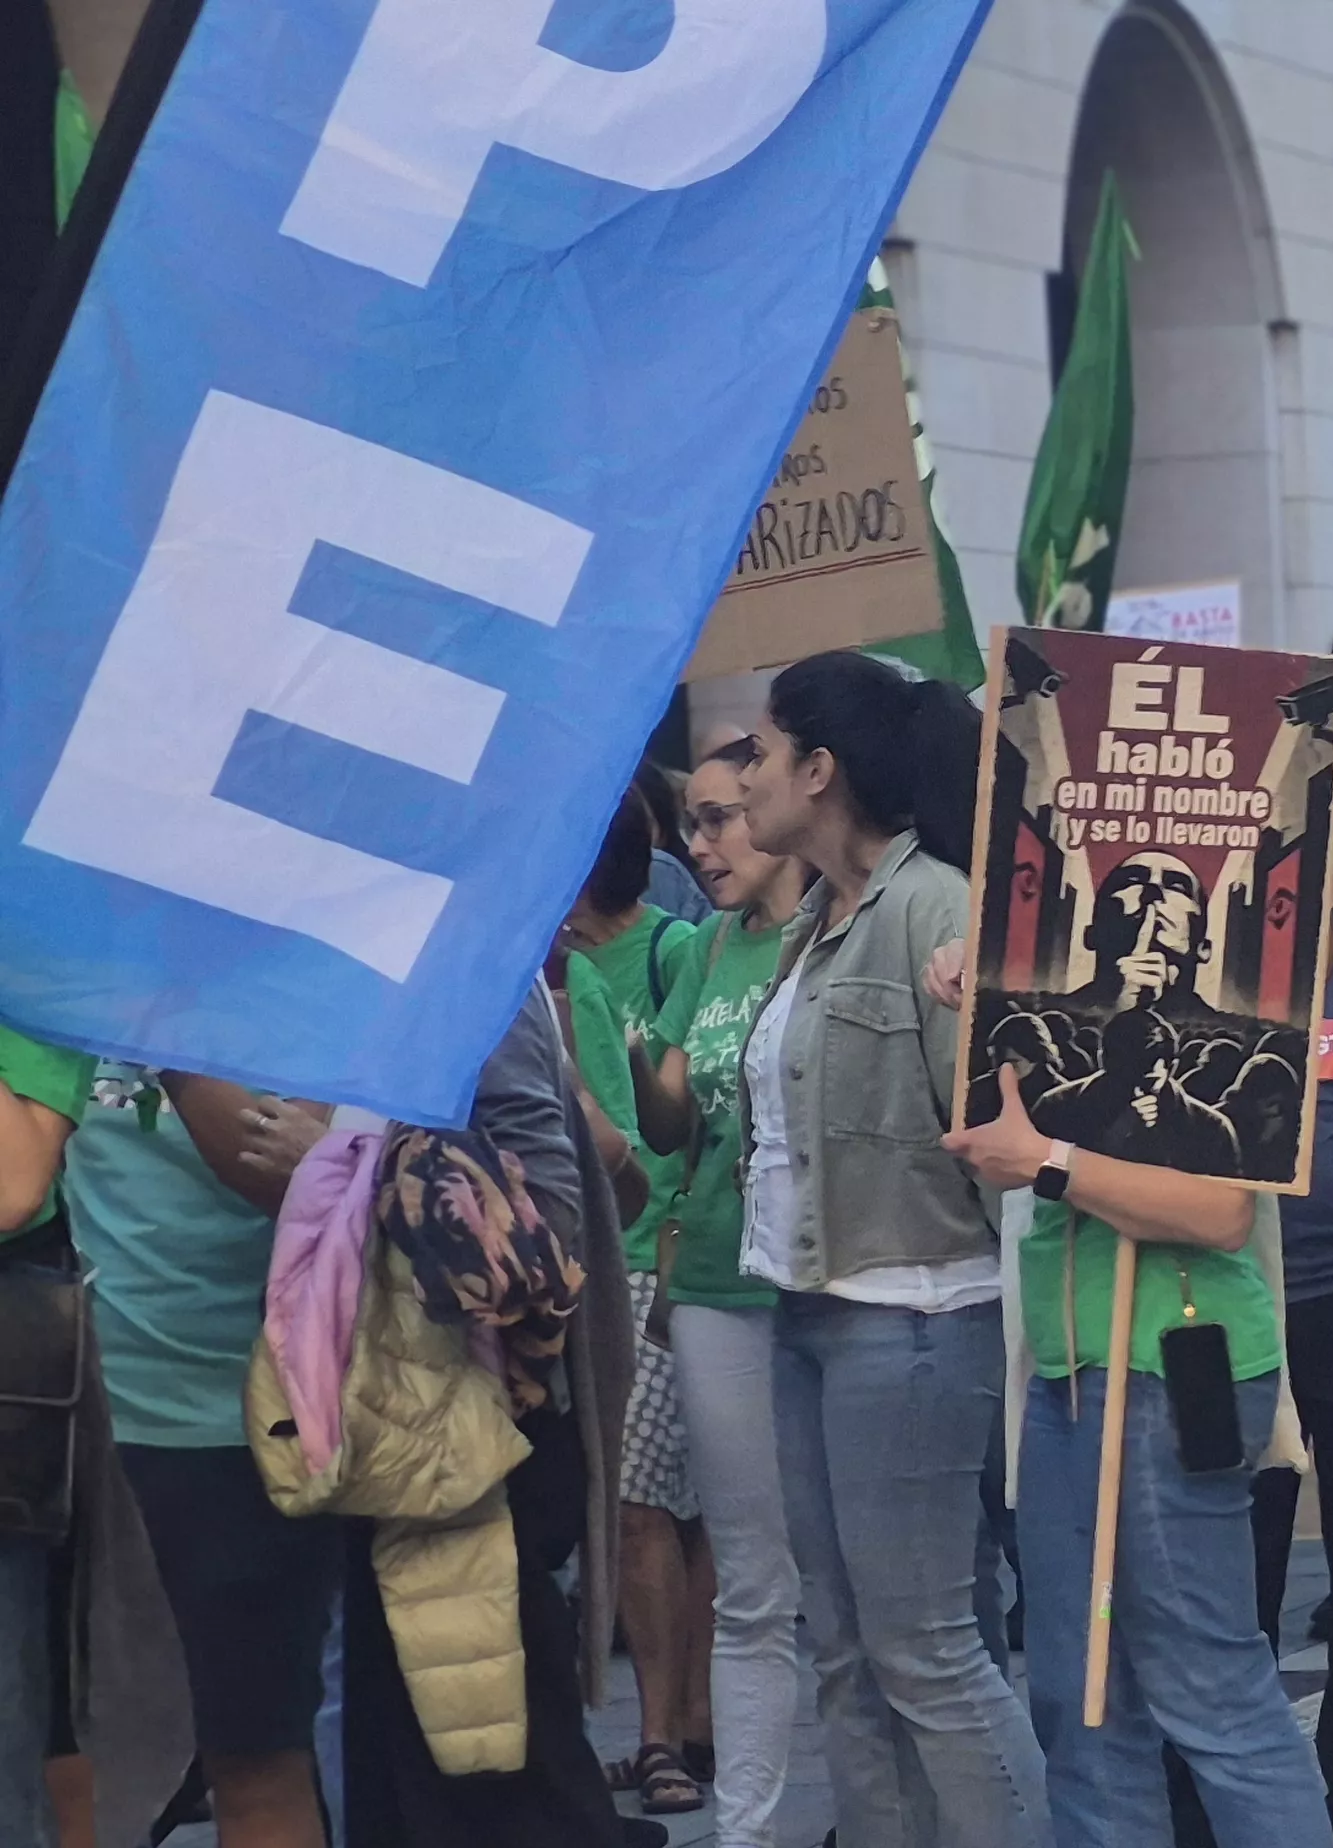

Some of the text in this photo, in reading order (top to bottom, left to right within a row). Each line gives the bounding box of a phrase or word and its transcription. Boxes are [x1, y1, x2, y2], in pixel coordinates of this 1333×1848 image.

[1107, 646, 1230, 734] ÉL
[1096, 731, 1235, 780] habló
[1057, 777, 1270, 819] en mi nombre
[1068, 815, 1261, 849] y se lo llevaron
